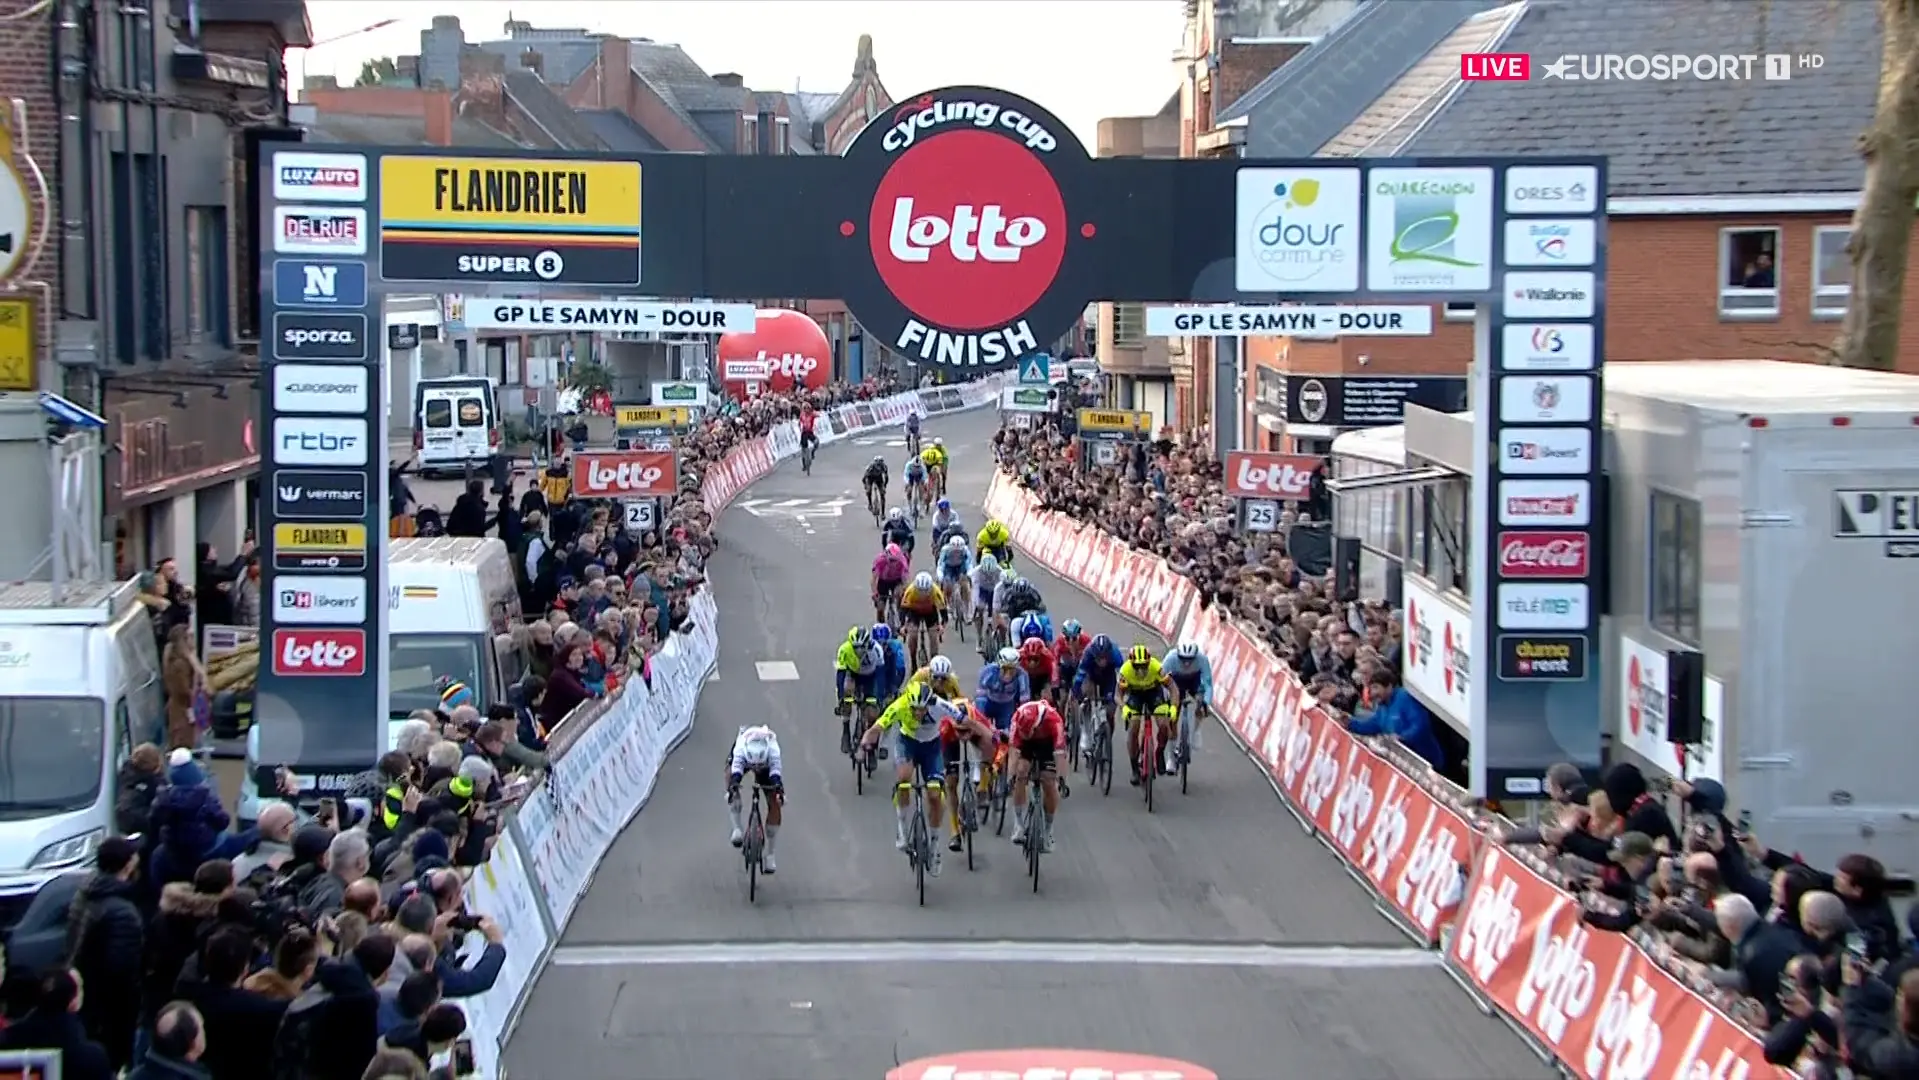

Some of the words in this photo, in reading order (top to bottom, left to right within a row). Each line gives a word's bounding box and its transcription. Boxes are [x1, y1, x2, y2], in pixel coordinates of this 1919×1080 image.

[882, 100, 1000, 151] cycling
[1000, 110, 1057, 152] cup
[282, 168, 357, 183] LUXAUTO
[435, 168, 587, 214] FLANDRIEN
[1513, 186, 1564, 201] ORES
[284, 217, 356, 238] DELRUE
[1258, 215, 1344, 247] dour
[457, 255, 531, 274] SUPER
[1259, 247, 1345, 266] commune
[303, 265, 338, 297] N
[1525, 287, 1587, 302] Wallonie
[493, 305, 524, 323] GP
[529, 307, 554, 324] LE
[559, 307, 639, 326] SAMYN
[662, 309, 727, 328] DOUR
[1174, 313, 1205, 330] GP
[1209, 313, 1233, 330] LE
[1238, 313, 1317, 330] SAMYN
[1338, 313, 1404, 330] DOUR
[896, 319, 1038, 365] FINISH
[285, 383, 358, 394] EUROSPORT
[283, 431, 358, 451] rtbf
[305, 488, 363, 500] vermarc
[628, 507, 651, 523] 25
[1251, 508, 1273, 524] 25
[292, 527, 349, 546] FLANDRIEN
